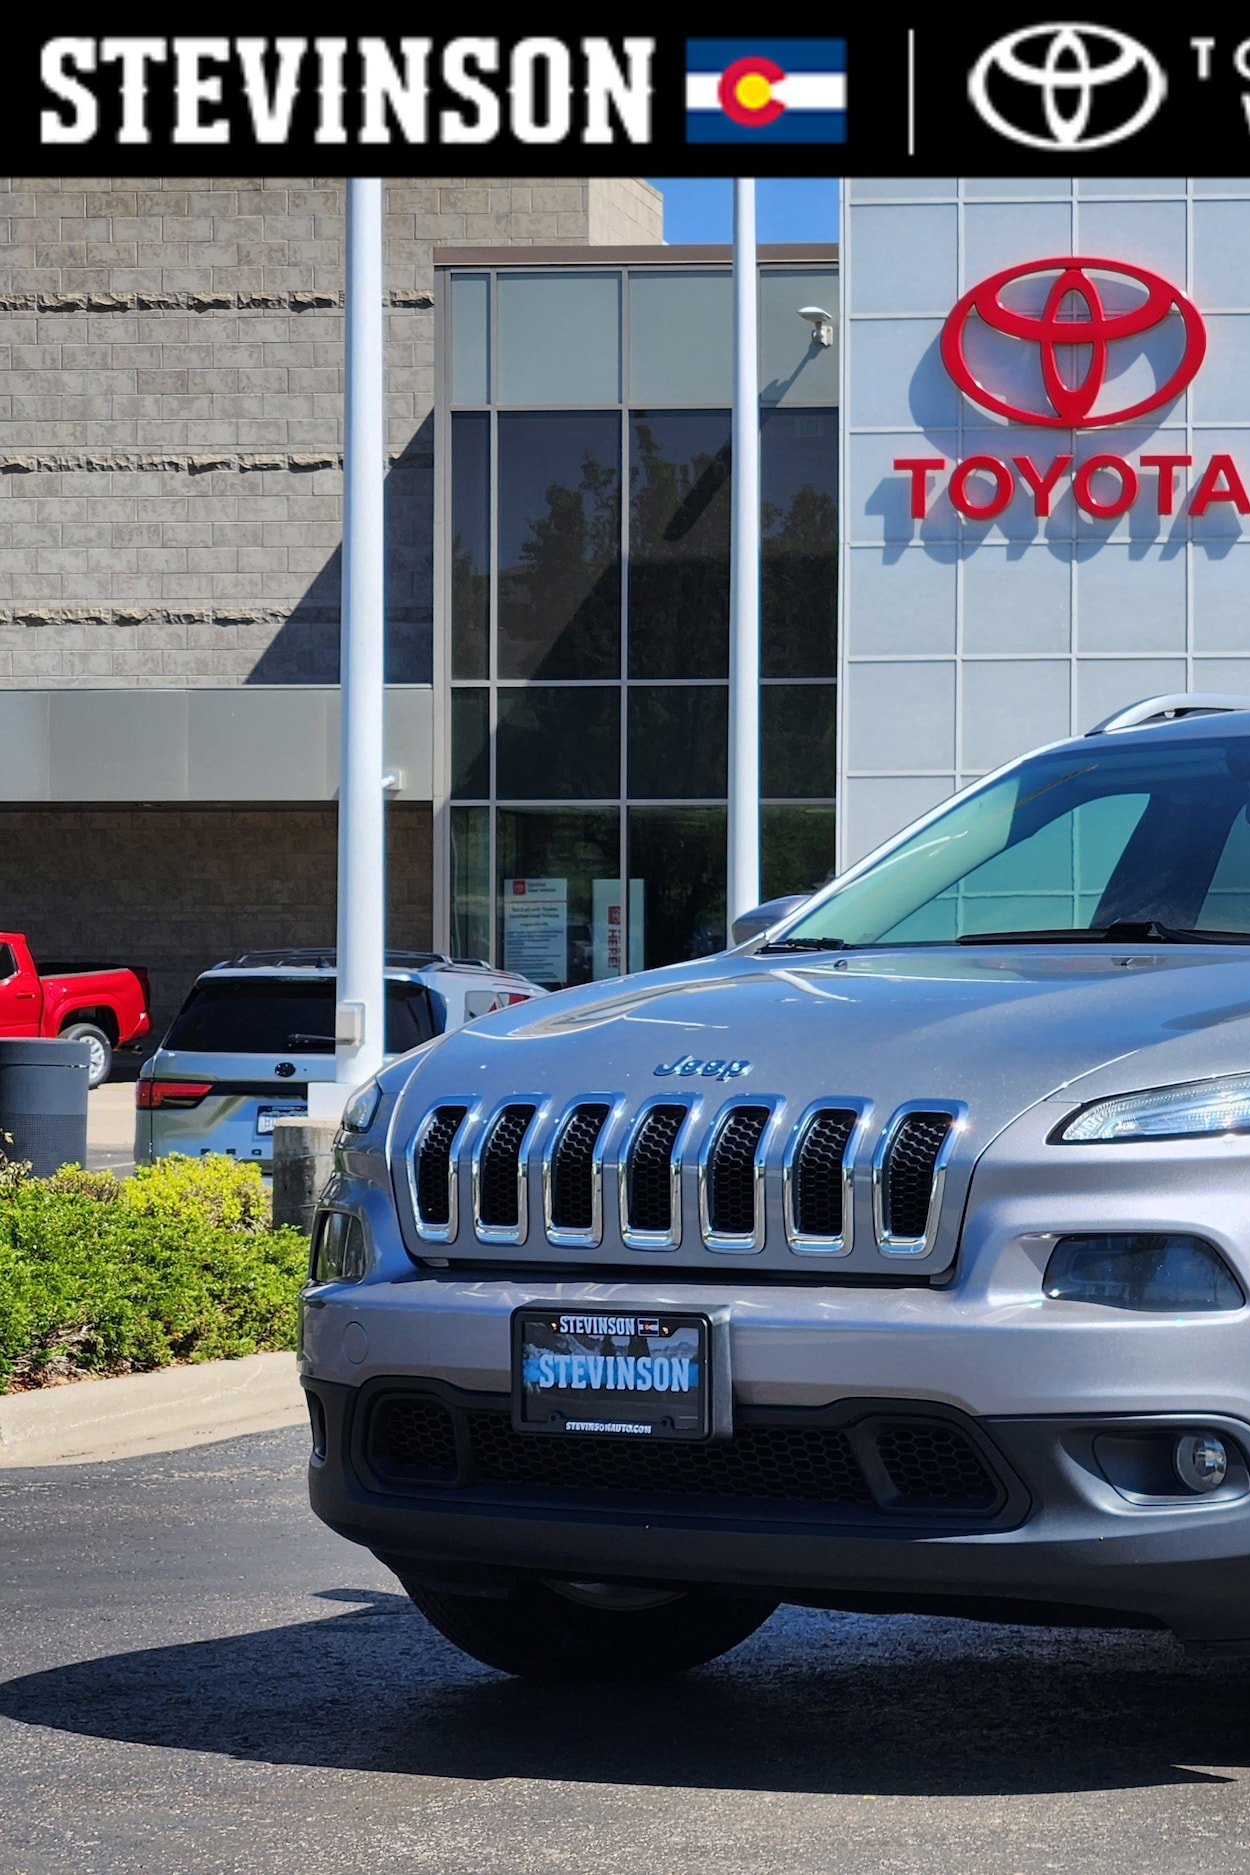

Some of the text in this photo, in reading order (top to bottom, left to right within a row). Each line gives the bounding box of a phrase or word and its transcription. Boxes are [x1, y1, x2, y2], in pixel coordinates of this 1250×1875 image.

[653, 1055, 753, 1083] Jeep
[560, 1315, 635, 1336] STEVINSON
[539, 1354, 690, 1392] STEVINSON
[565, 1421, 652, 1434] STEVINSONAUTO.COM
